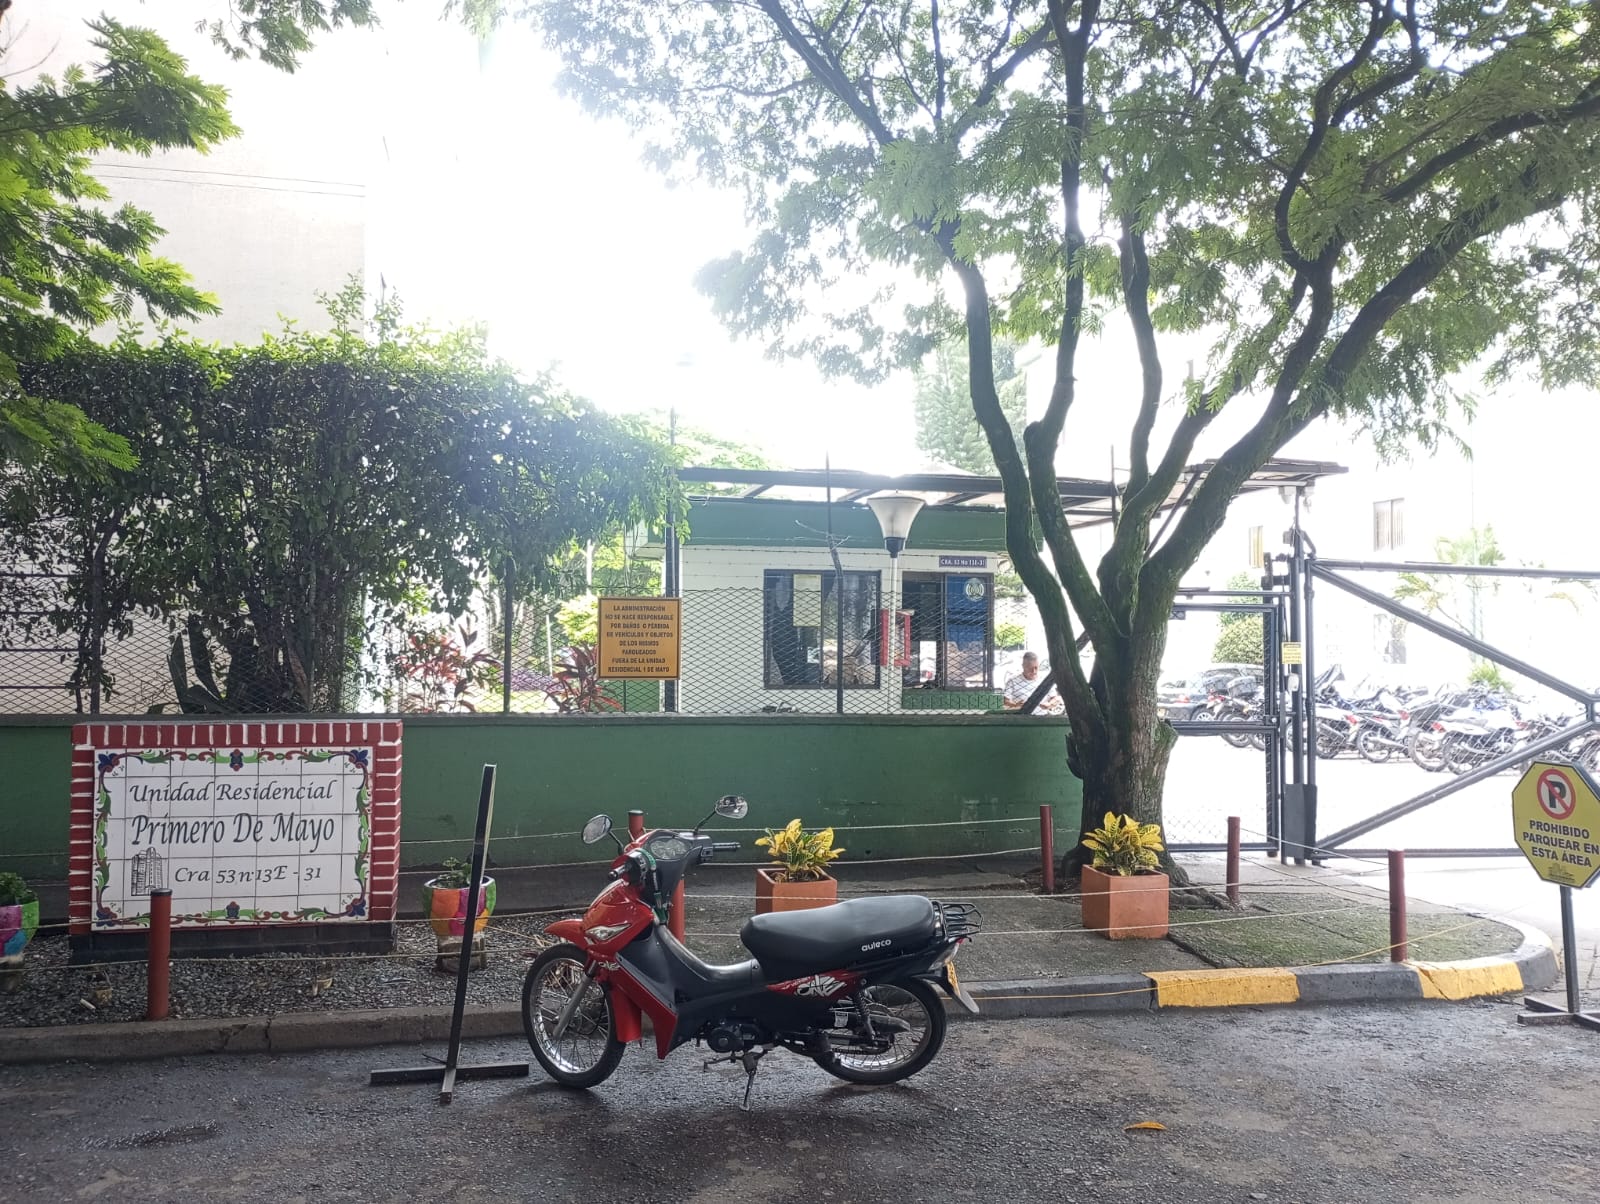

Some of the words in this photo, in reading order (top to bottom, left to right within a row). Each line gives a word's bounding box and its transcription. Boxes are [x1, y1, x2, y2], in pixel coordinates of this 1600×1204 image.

[130, 781, 214, 802] Unidad
[216, 779, 338, 800] Residencial
[131, 812, 225, 846] Primero
[233, 812, 264, 842] De
[270, 812, 334, 853] Mayo
[1529, 820, 1590, 839] PROHIBIDO
[1522, 832, 1580, 852] PARQUEAR
[1584, 843, 1600, 855] EN
[1531, 846, 1558, 861] ESTA
[1562, 850, 1592, 868] ÁREA
[174, 867, 210, 882] Cra
[304, 866, 321, 881] 31
[861, 938, 892, 952] auteco
